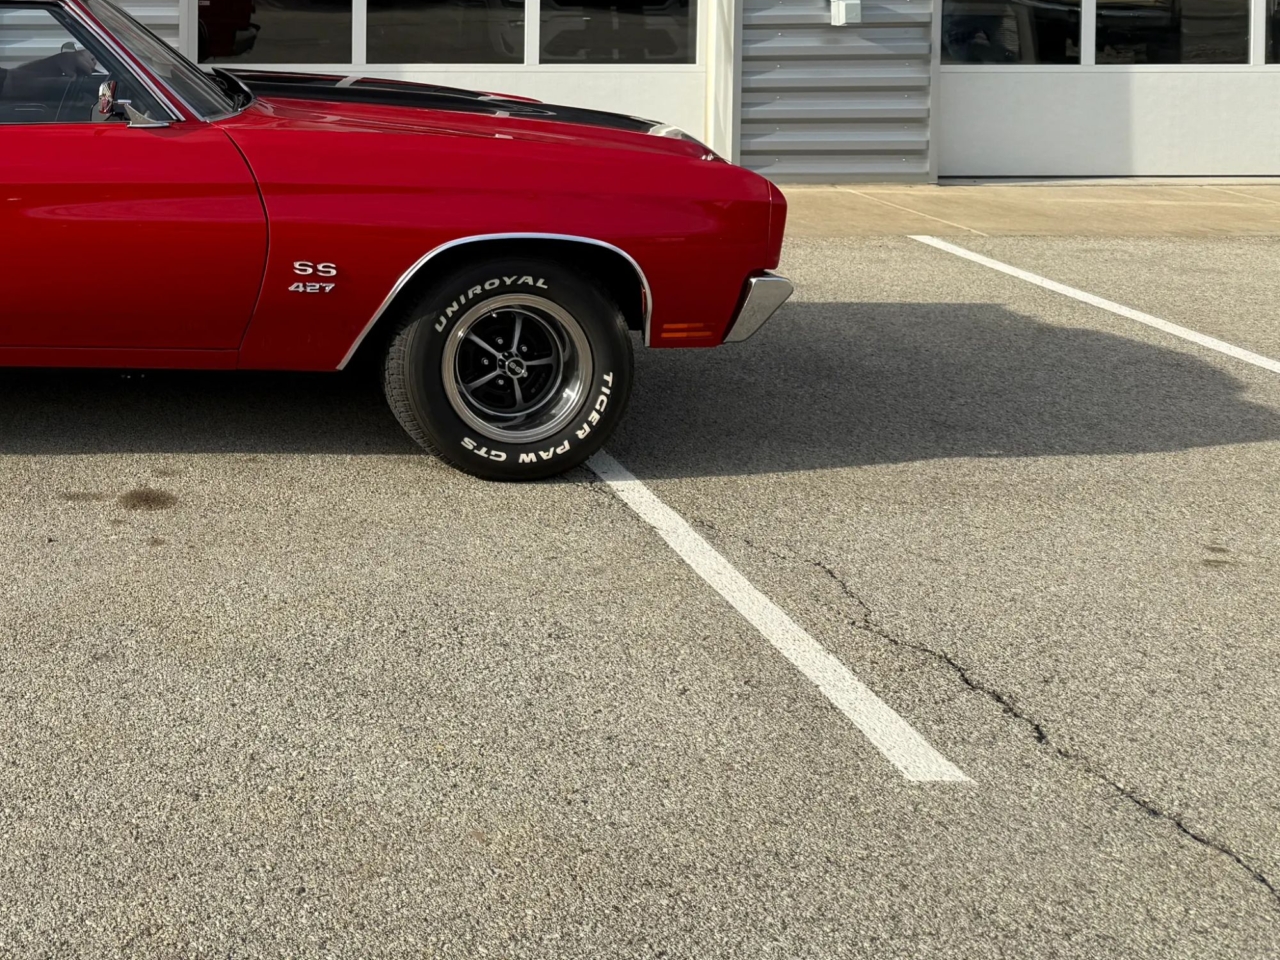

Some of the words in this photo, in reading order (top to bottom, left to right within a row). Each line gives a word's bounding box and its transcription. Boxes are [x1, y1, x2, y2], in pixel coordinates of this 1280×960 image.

[293, 261, 337, 277] SS
[288, 282, 335, 293] 427
[435, 275, 549, 332] UNIROYAL
[575, 371, 613, 439] TIGER
[460, 437, 507, 462] GTS
[519, 439, 571, 464] PAW
